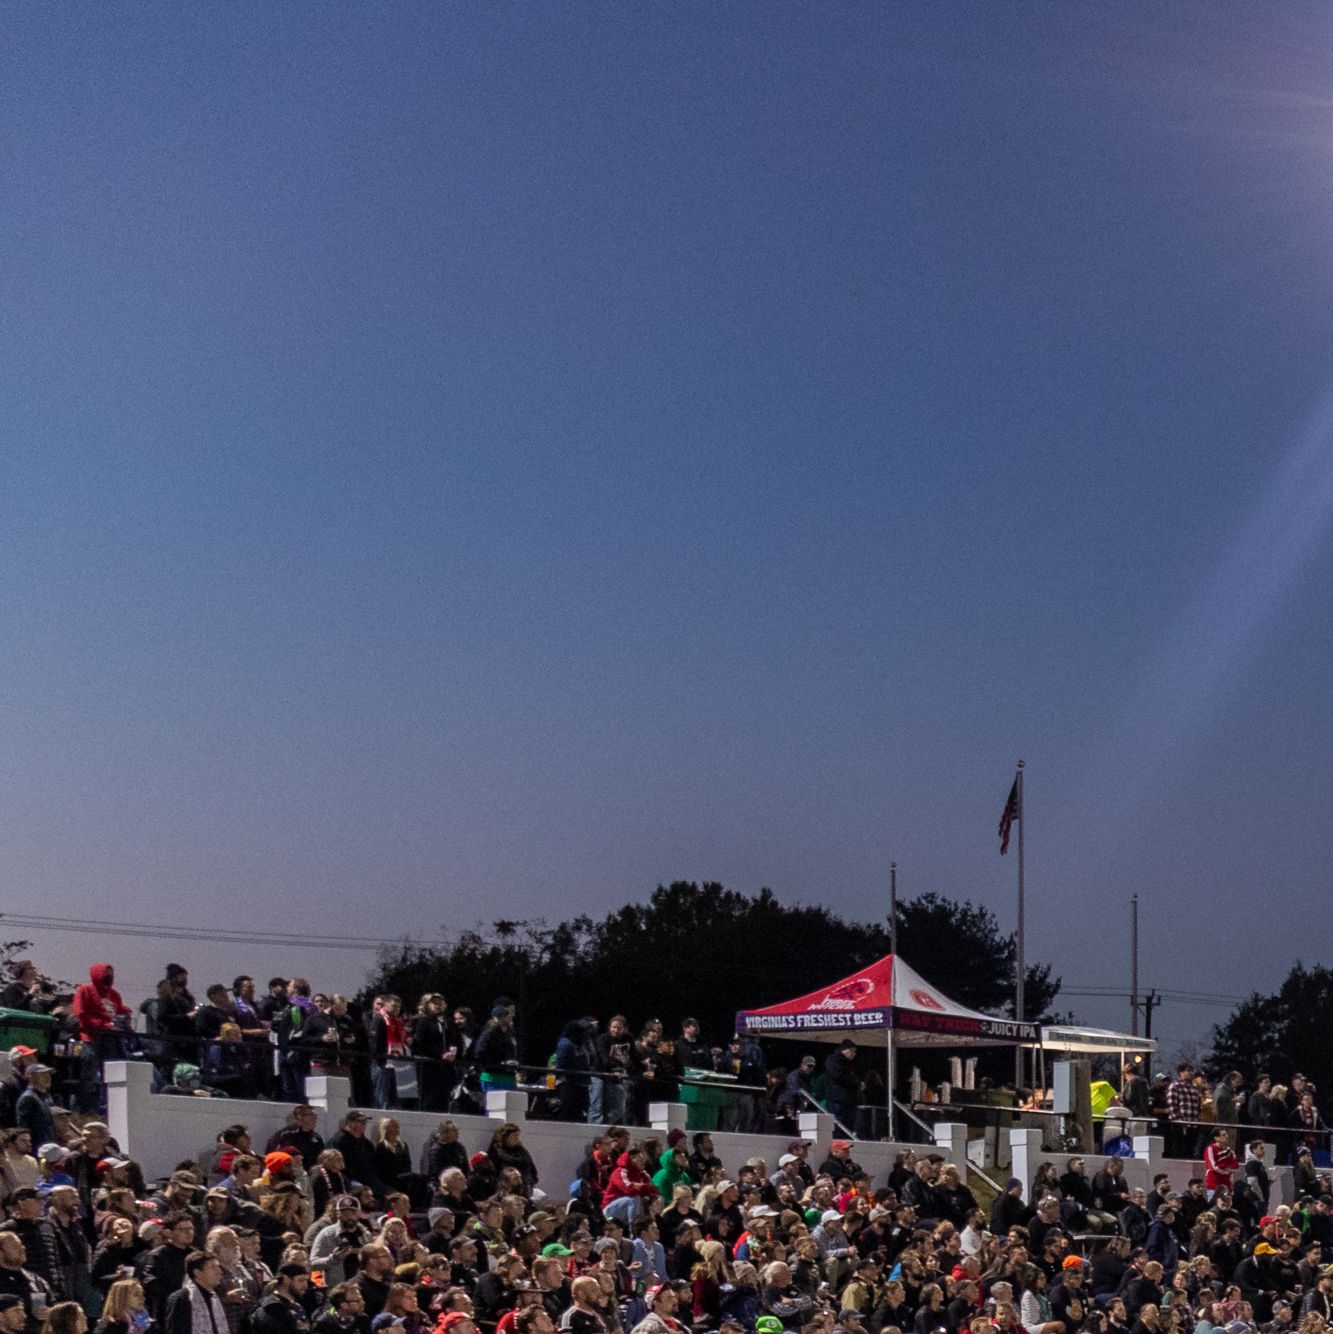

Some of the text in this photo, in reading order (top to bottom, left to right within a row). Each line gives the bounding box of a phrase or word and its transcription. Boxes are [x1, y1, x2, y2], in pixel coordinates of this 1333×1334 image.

[745, 1015, 795, 1029] VIRGINIA'S
[796, 1014, 852, 1027] FRESHEST
[853, 1012, 884, 1024] BEER
[989, 1023, 1037, 1038] JUICY IPA
